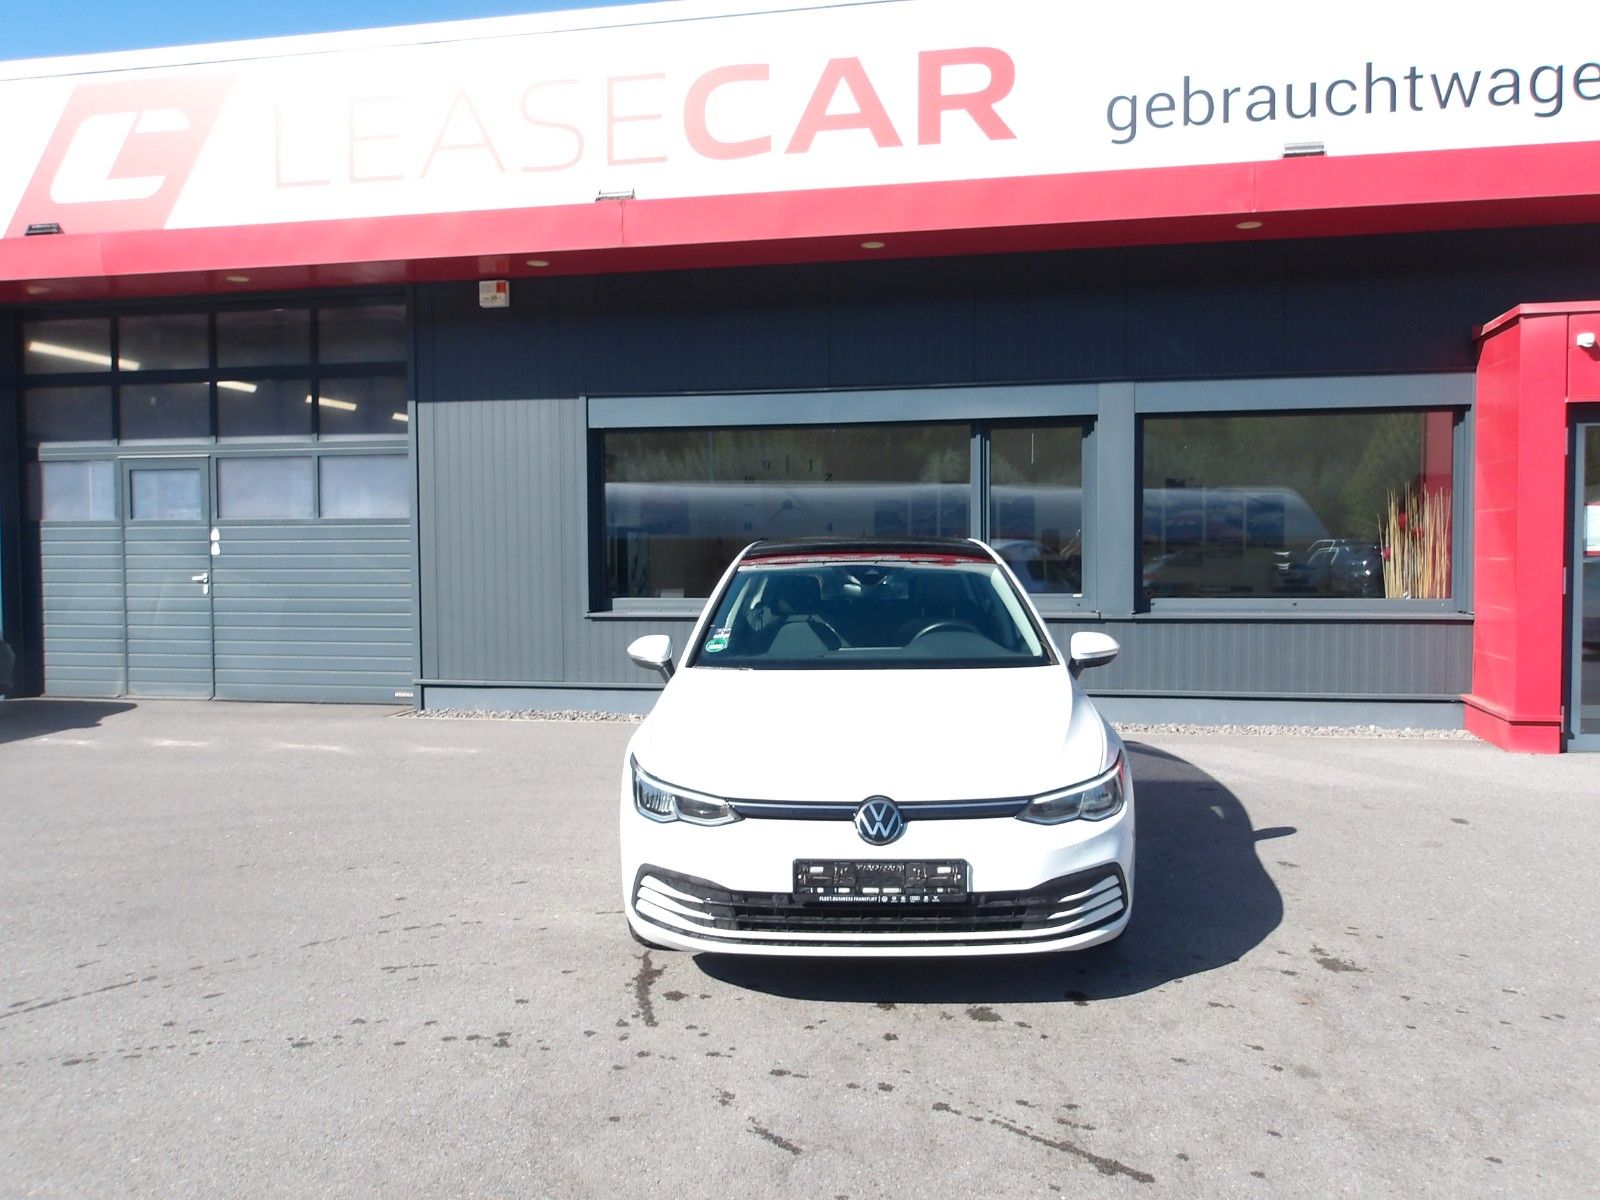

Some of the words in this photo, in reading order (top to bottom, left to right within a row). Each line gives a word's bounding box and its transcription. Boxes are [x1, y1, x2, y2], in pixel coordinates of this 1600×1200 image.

[275, 46, 1018, 188] LEASECAR
[1106, 60, 1600, 145] gebrauchtwage
[859, 800, 901, 840] VW
